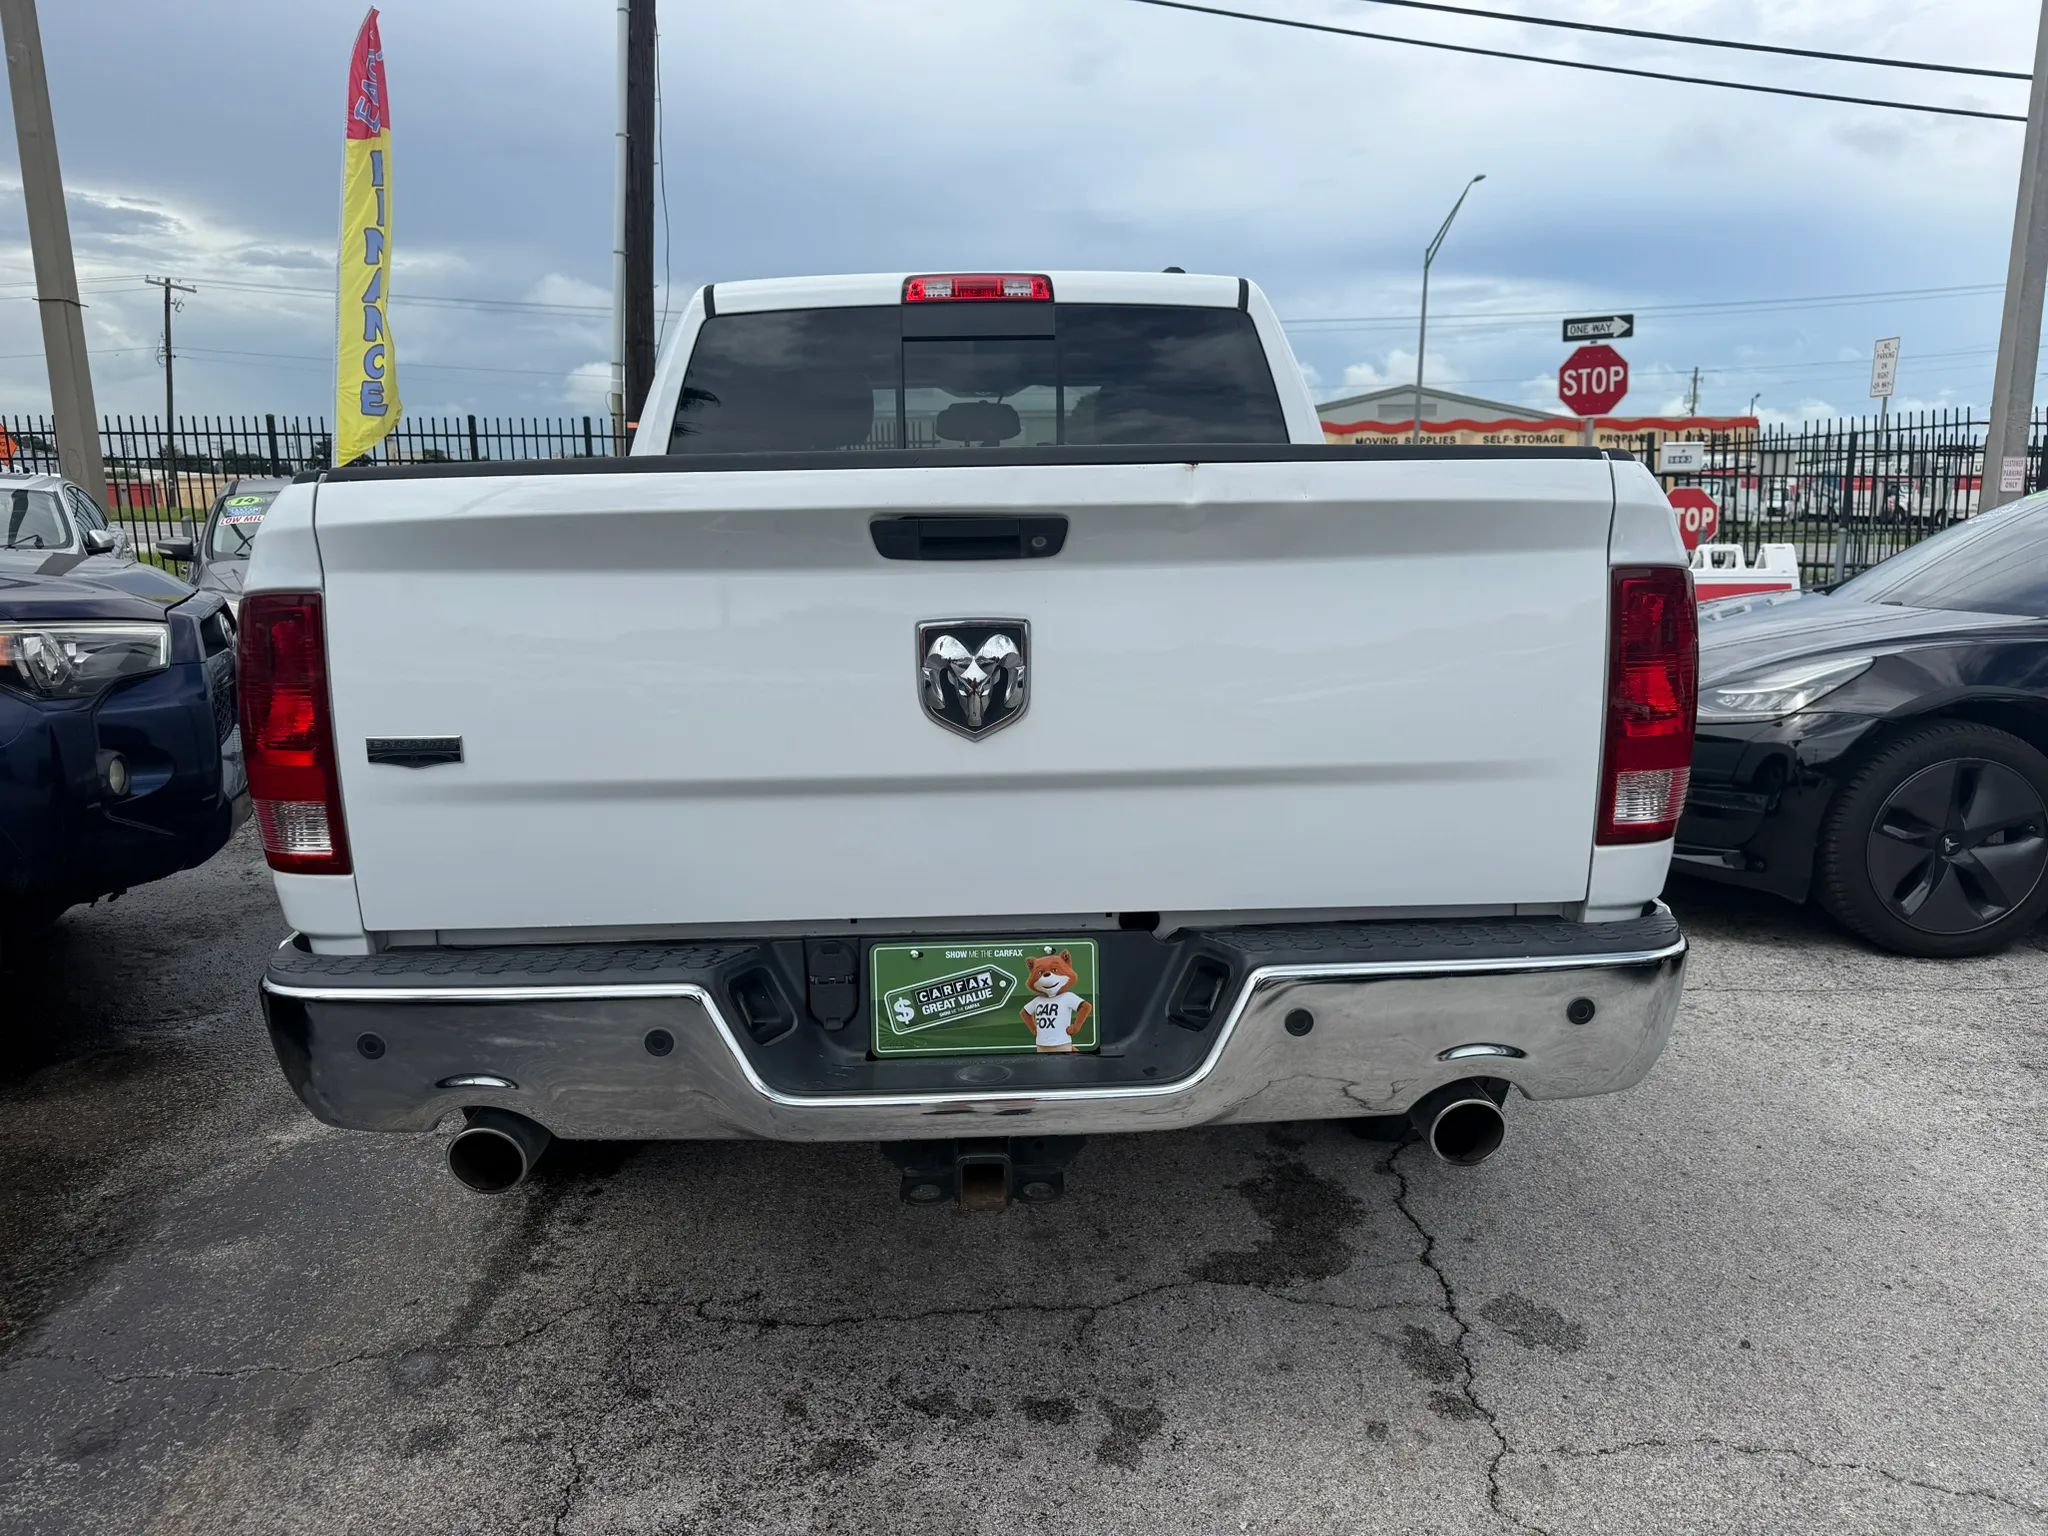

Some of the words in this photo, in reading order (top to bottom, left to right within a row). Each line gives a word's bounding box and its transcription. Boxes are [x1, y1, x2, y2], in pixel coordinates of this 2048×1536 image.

[354, 33, 384, 133] EAS
[1569, 324, 1589, 335] ONE
[1592, 322, 1612, 333] WAY
[1563, 366, 1625, 396] STOP
[1355, 436, 1398, 445] MOVING
[1482, 434, 1565, 444] SELF-STORAGE
[221, 516, 241, 525] LOW
[1675, 507, 1714, 532] TOP
[945, 950, 967, 959] SHOW
[968, 950, 979, 958] ME
[980, 949, 993, 958] THE
[994, 949, 1024, 957] CARFAX
[916, 974, 992, 1004] CARFAX
[921, 998, 957, 1015] GREAT
[957, 988, 993, 1005] VALUE
[1035, 1003, 1059, 1016] CAR
